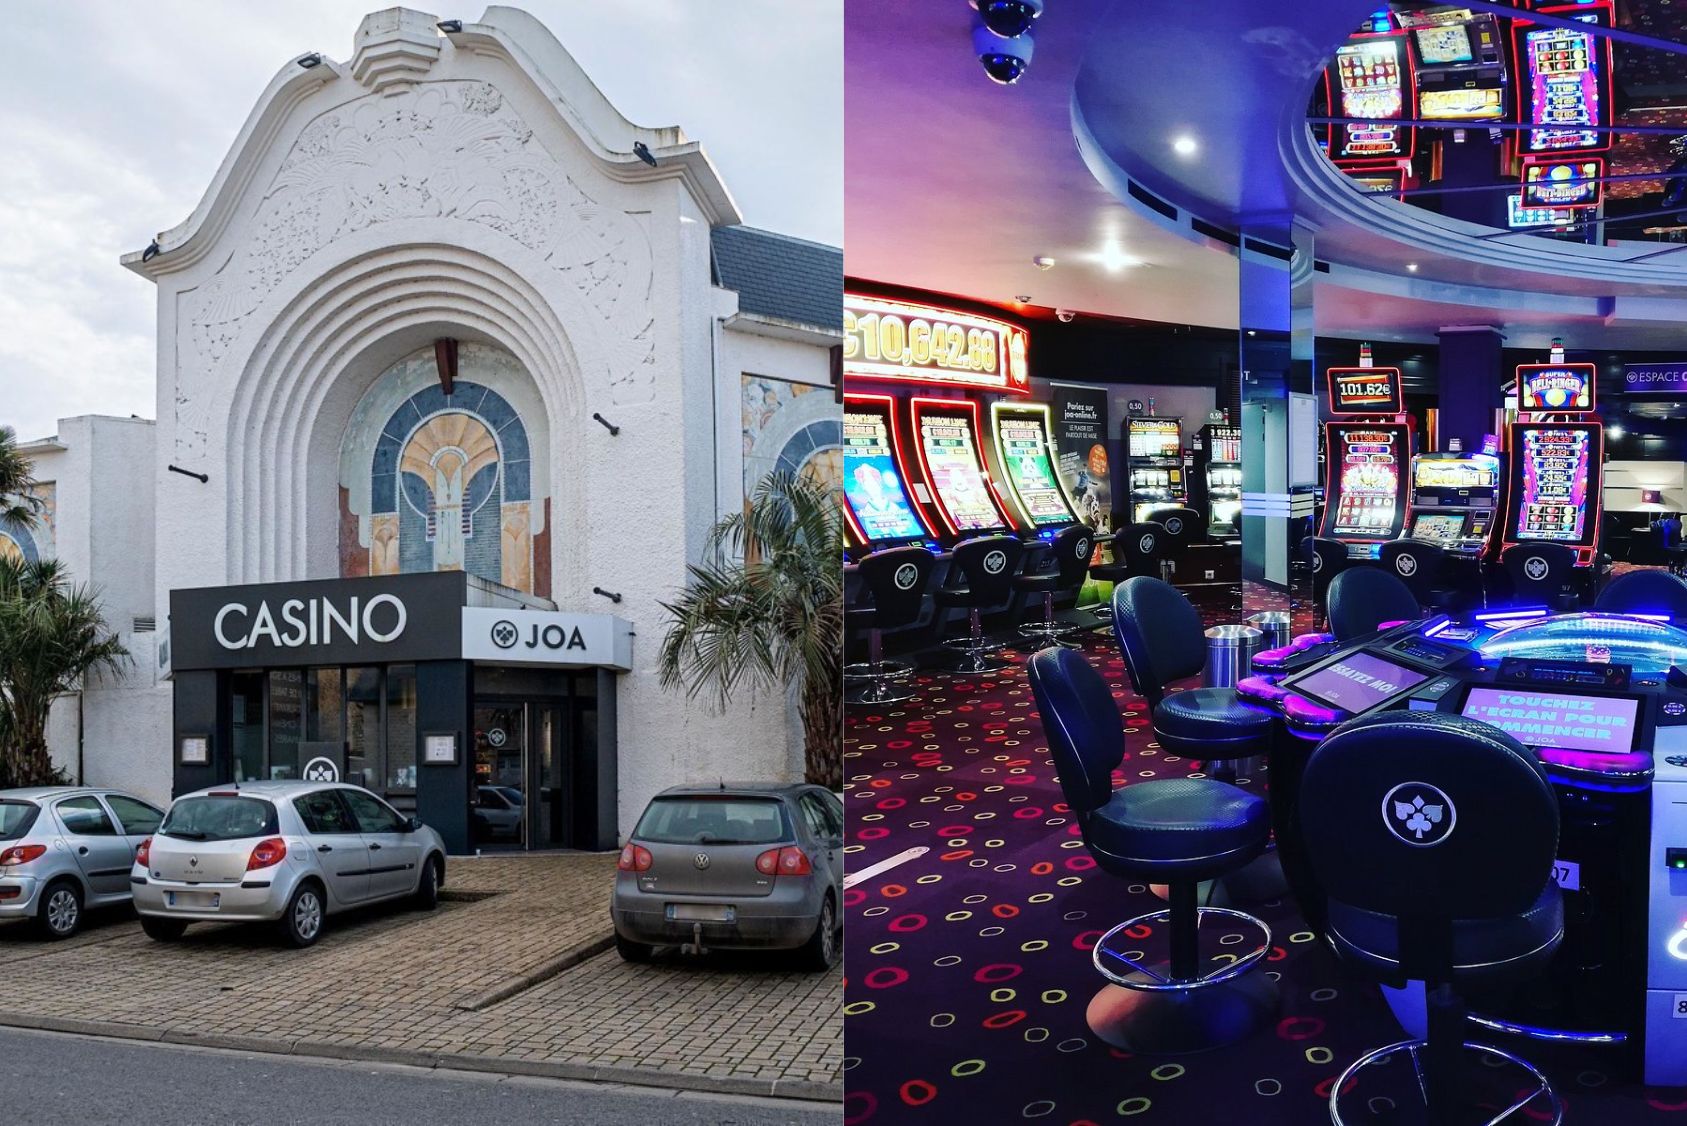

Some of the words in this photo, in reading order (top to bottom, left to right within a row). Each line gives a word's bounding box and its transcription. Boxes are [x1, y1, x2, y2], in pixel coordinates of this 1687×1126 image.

[1639, 371, 1679, 382] ESPACE
[1064, 409, 1097, 420] joa-online.fr
[214, 593, 407, 650] CASINO
[525, 623, 587, 651] JOA
[1327, 663, 1375, 684] ESSAYEZ
[1368, 679, 1399, 694] MOI
[1498, 694, 1597, 711] TOUCHEZ
[1468, 705, 1558, 721] L'ECRAN
[1564, 712, 1628, 727] POUR
[1484, 720, 1612, 740] OMMENCER
